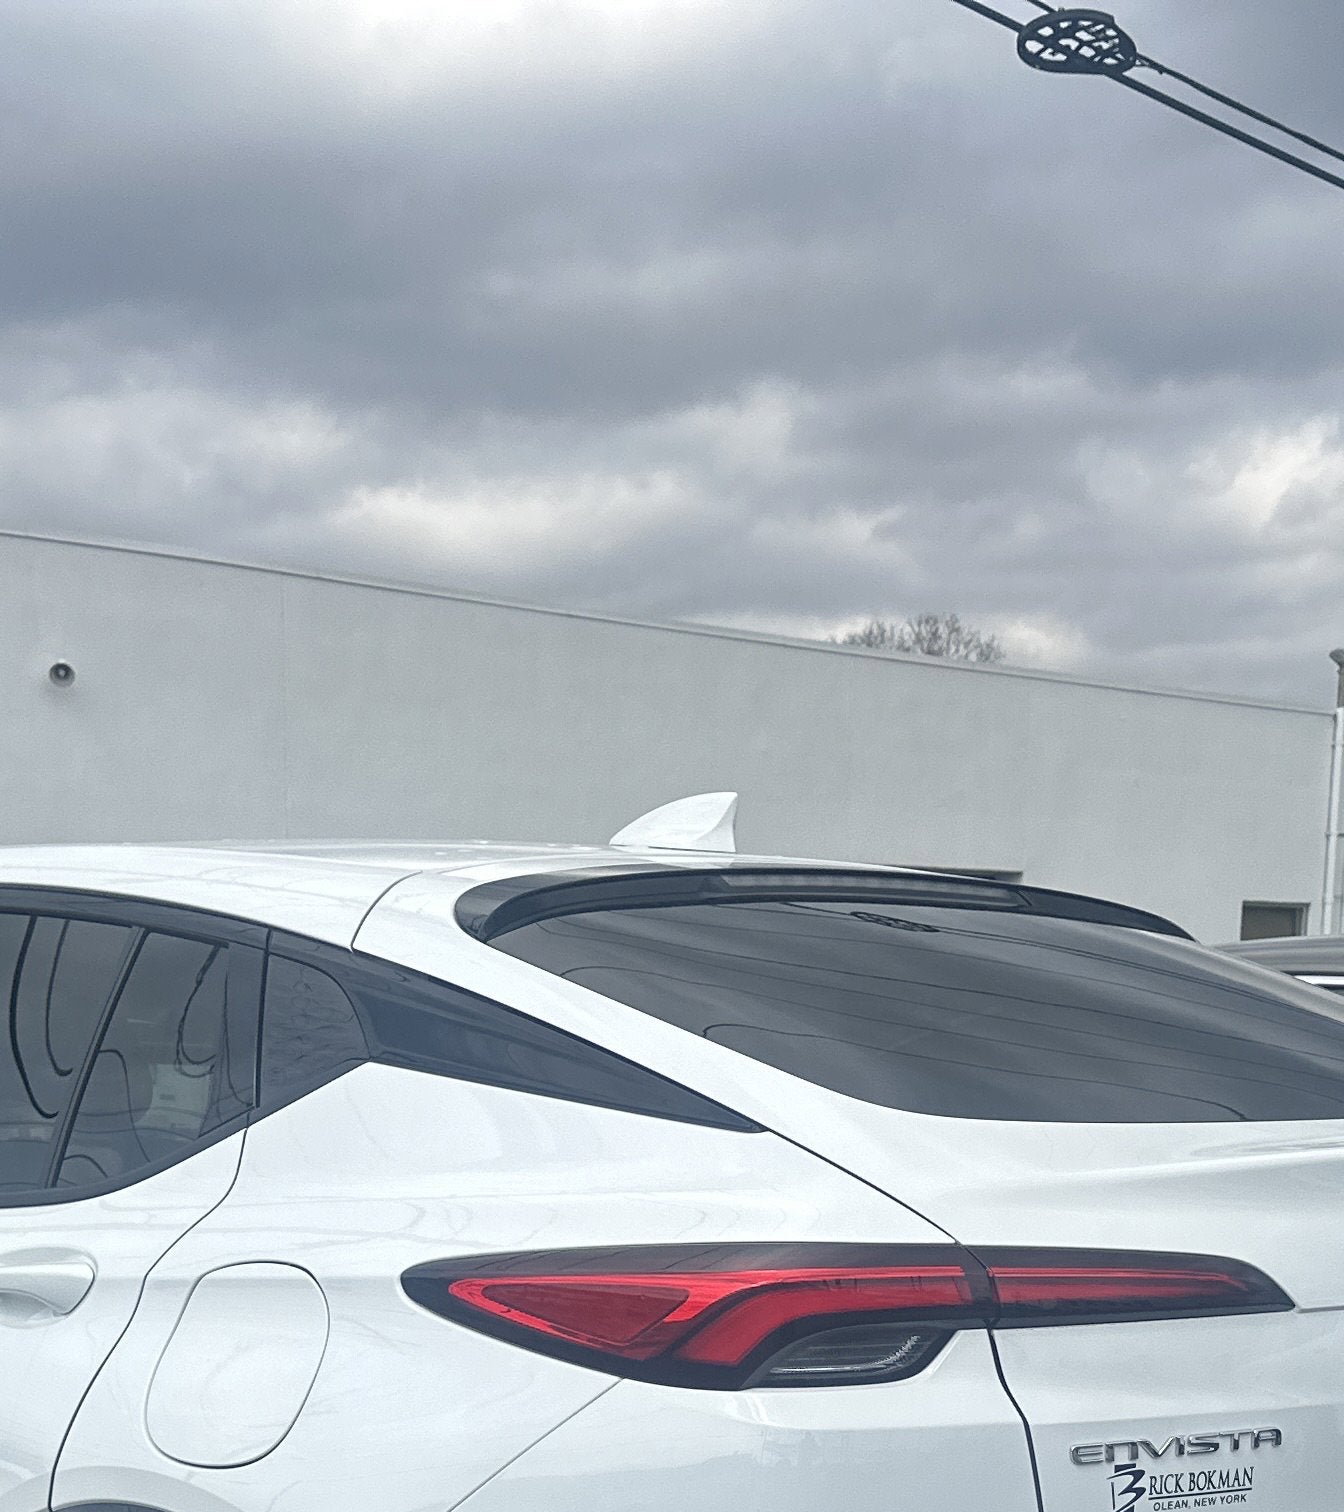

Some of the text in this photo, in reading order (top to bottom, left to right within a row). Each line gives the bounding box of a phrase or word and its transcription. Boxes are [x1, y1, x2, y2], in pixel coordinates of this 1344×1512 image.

[1069, 1425, 1283, 1467] ENVISTA
[1188, 1466, 1254, 1492] BOKMAN
[1153, 1493, 1247, 1512] OLEAN, NEW YORK
